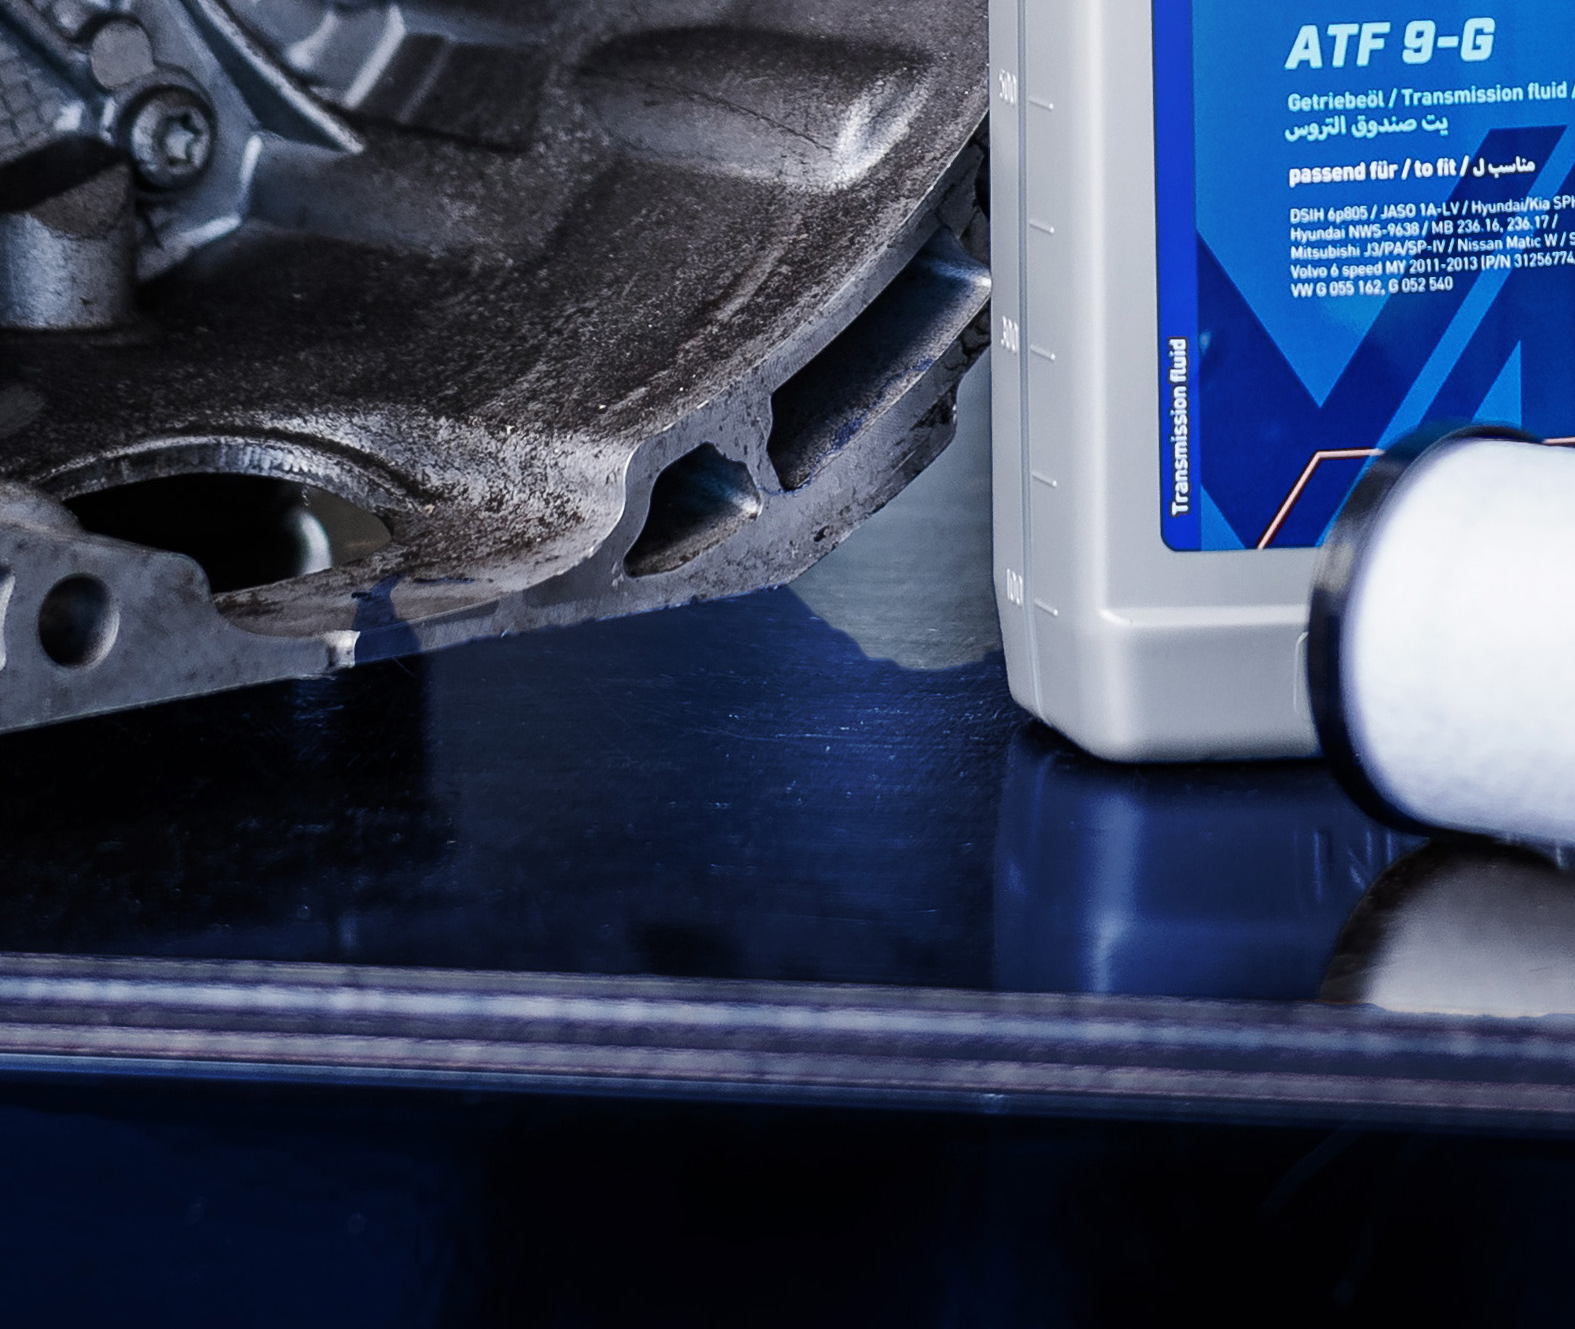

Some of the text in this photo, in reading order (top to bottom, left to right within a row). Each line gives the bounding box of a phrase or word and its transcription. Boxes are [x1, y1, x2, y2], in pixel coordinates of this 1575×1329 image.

[1284, 17, 1496, 70] ATF 9-G
[1287, 81, 1567, 112] Getriebeöl Transmission fluid
[1285, 115, 1347, 142] التروس
[1351, 115, 1417, 138] صندوق
[1289, 157, 1457, 188] passend für to fit
[1488, 156, 1536, 179] مناسب
[1289, 207, 1325, 224] DSIH
[1327, 205, 1368, 224] 6p805
[1380, 203, 1416, 220] JASO
[1420, 200, 1460, 218] 1A-LV
[1471, 196, 1551, 217] Hyundai/Kia
[1290, 214, 1549, 245] Hyundai NWS-9638 MB 236.16, 236.17
[1290, 242, 1361, 260] Mitsubishi
[1363, 238, 1446, 258] J3/PA/SP-IV
[1457, 237, 1503, 254] Nissan
[1506, 234, 1541, 251] Matic
[1544, 233, 1558, 248] W
[1290, 263, 1328, 280] Volvo
[1330, 262, 1339, 279] 6
[1342, 260, 1383, 281] speed
[1385, 258, 1407, 275] MY
[1409, 256, 1479, 275] 2011-2013
[1290, 275, 1453, 299] VW G 055 162, G 052 540
[1169, 338, 1189, 516] Transmission fluid
